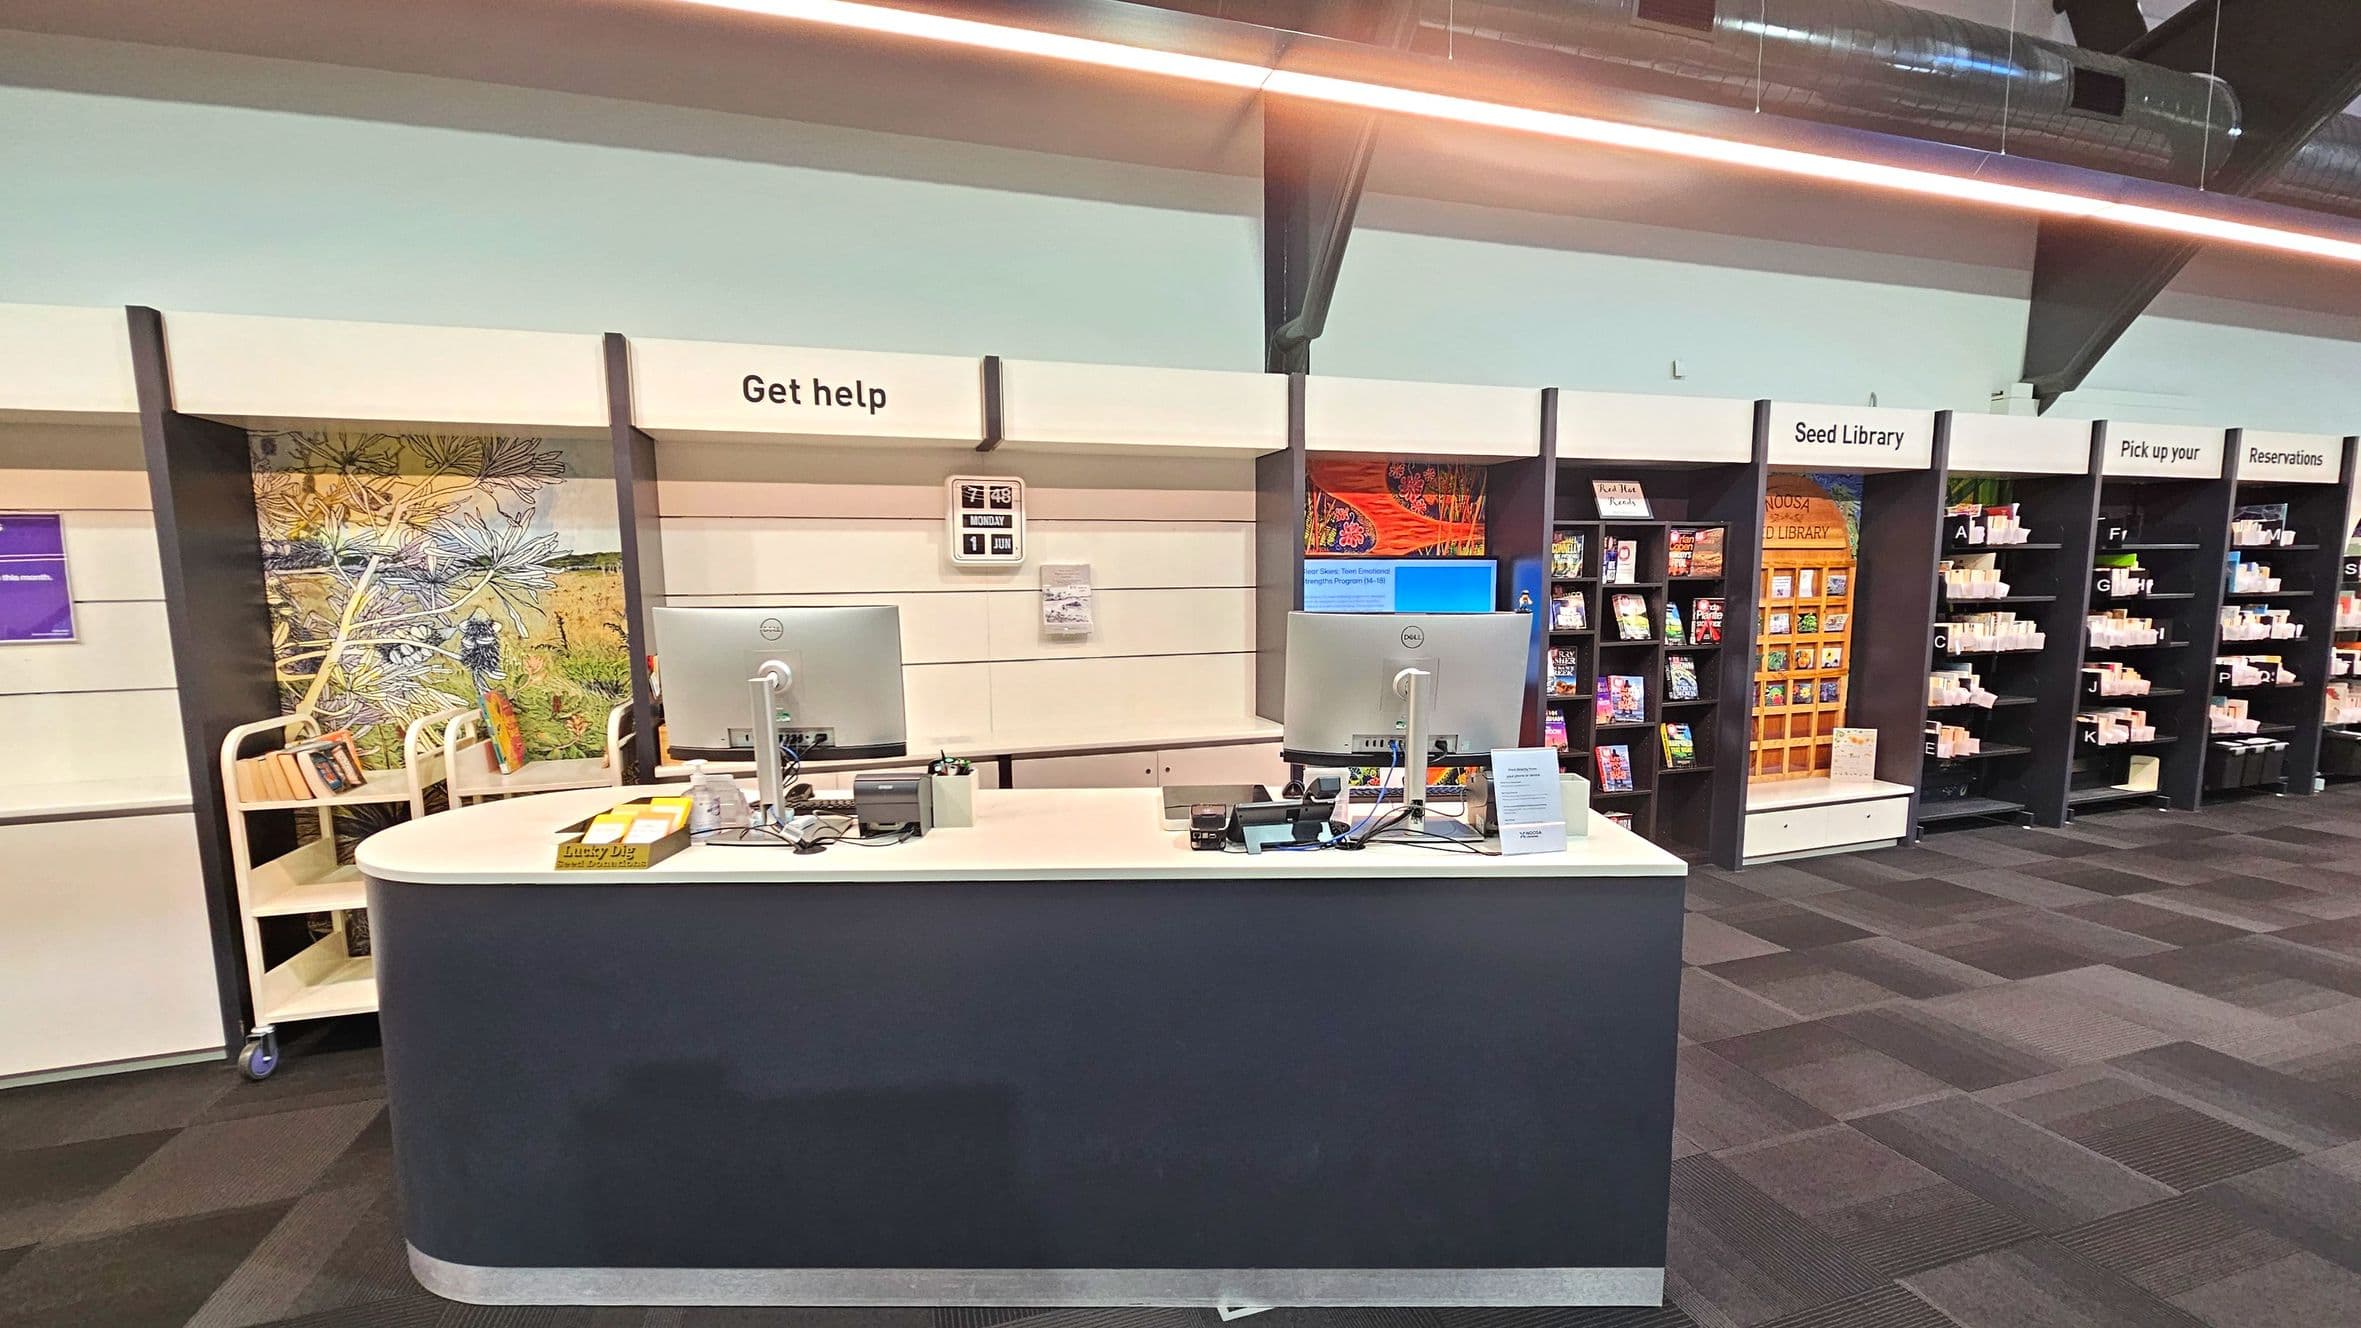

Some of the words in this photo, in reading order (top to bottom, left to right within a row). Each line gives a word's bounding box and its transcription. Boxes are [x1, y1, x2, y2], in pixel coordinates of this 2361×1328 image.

[743, 374, 802, 404] Get
[813, 378, 887, 415] help
[1795, 422, 1837, 443] Seed
[1843, 425, 1904, 450] Library
[2120, 440, 2149, 458] Pick
[2153, 446, 2168, 461] up
[2172, 447, 2200, 462] your
[2249, 448, 2323, 466] Reservations
[967, 486, 980, 503] 7
[991, 487, 1012, 504] 48
[1599, 484, 1618, 493] Red
[1765, 494, 1810, 513] NOOSA
[970, 515, 1005, 527] MONDAY
[1778, 526, 1830, 539] LIBRARY
[1955, 525, 1968, 539] A
[969, 535, 977, 551] 1
[994, 537, 1011, 549] JUN
[1552, 543, 1582, 554] CONNELLY
[1358, 567, 1391, 575] Emotional
[2345, 563, 2358, 575] S
[2096, 579, 2110, 591] G
[1404, 633, 1422, 641] DELL
[1934, 635, 1946, 649] C
[2219, 672, 2231, 684] P
[2088, 681, 2098, 693] J
[2084, 731, 2097, 743] K
[1925, 742, 1936, 755] E
[564, 845, 609, 860] Lucky
[610, 845, 636, 860] Dig
